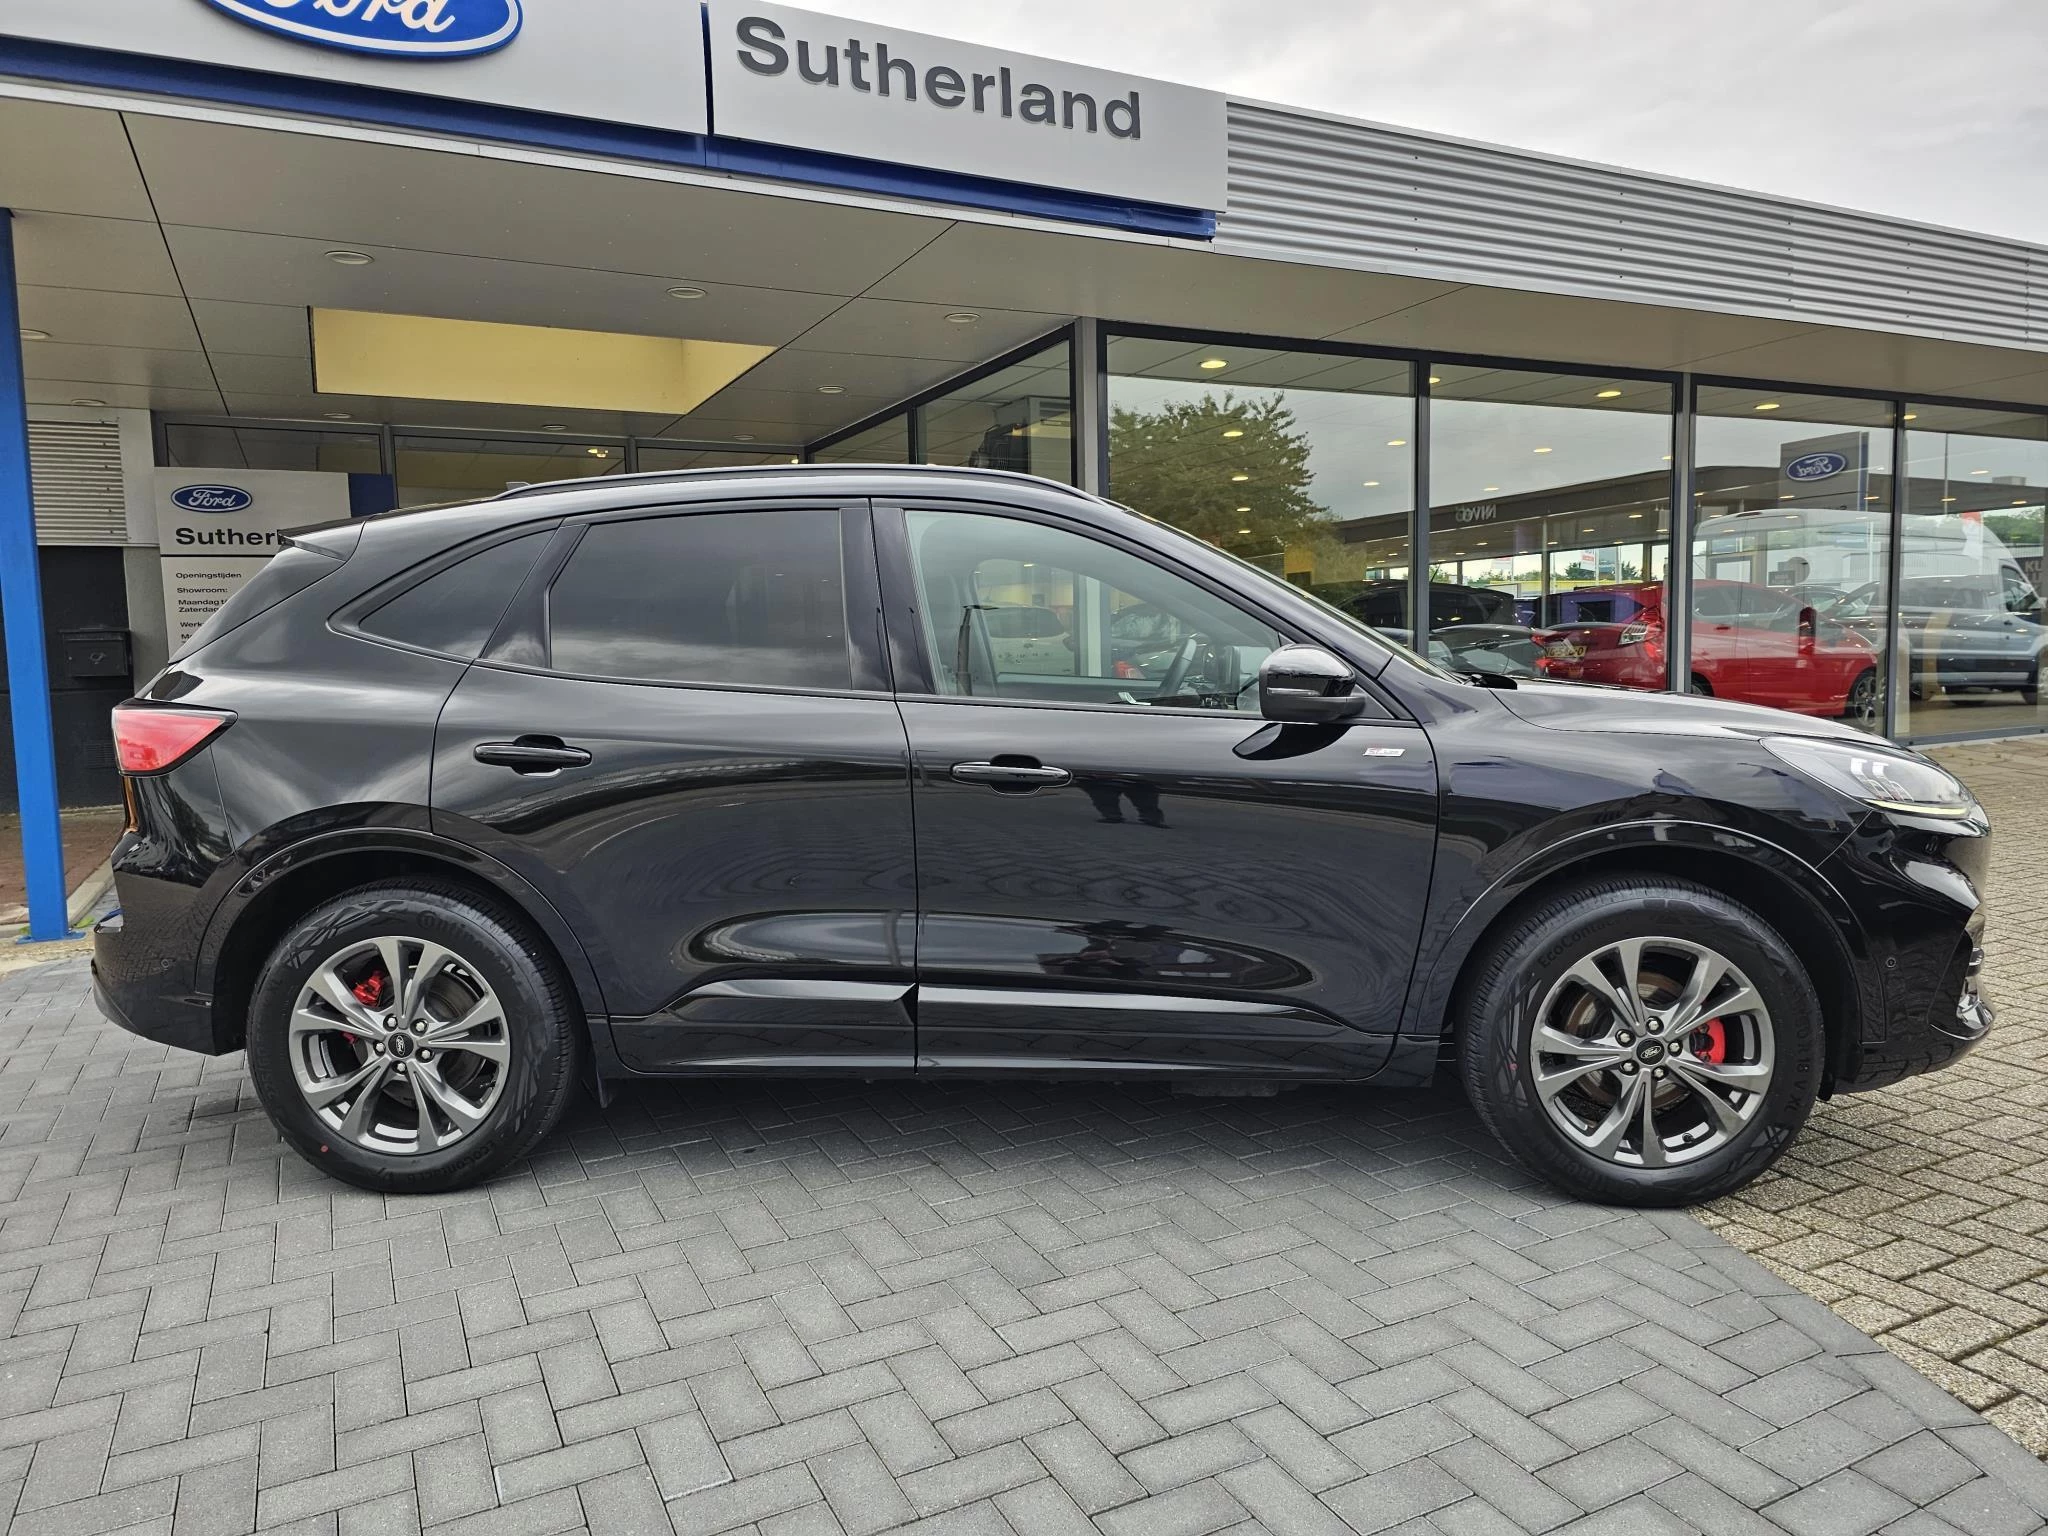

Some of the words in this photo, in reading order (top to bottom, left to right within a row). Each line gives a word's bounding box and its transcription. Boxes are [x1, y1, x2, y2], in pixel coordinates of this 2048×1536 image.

[736, 16, 1141, 140] Sutherland
[188, 489, 236, 507] Ford
[175, 527, 282, 545] Sutherl
